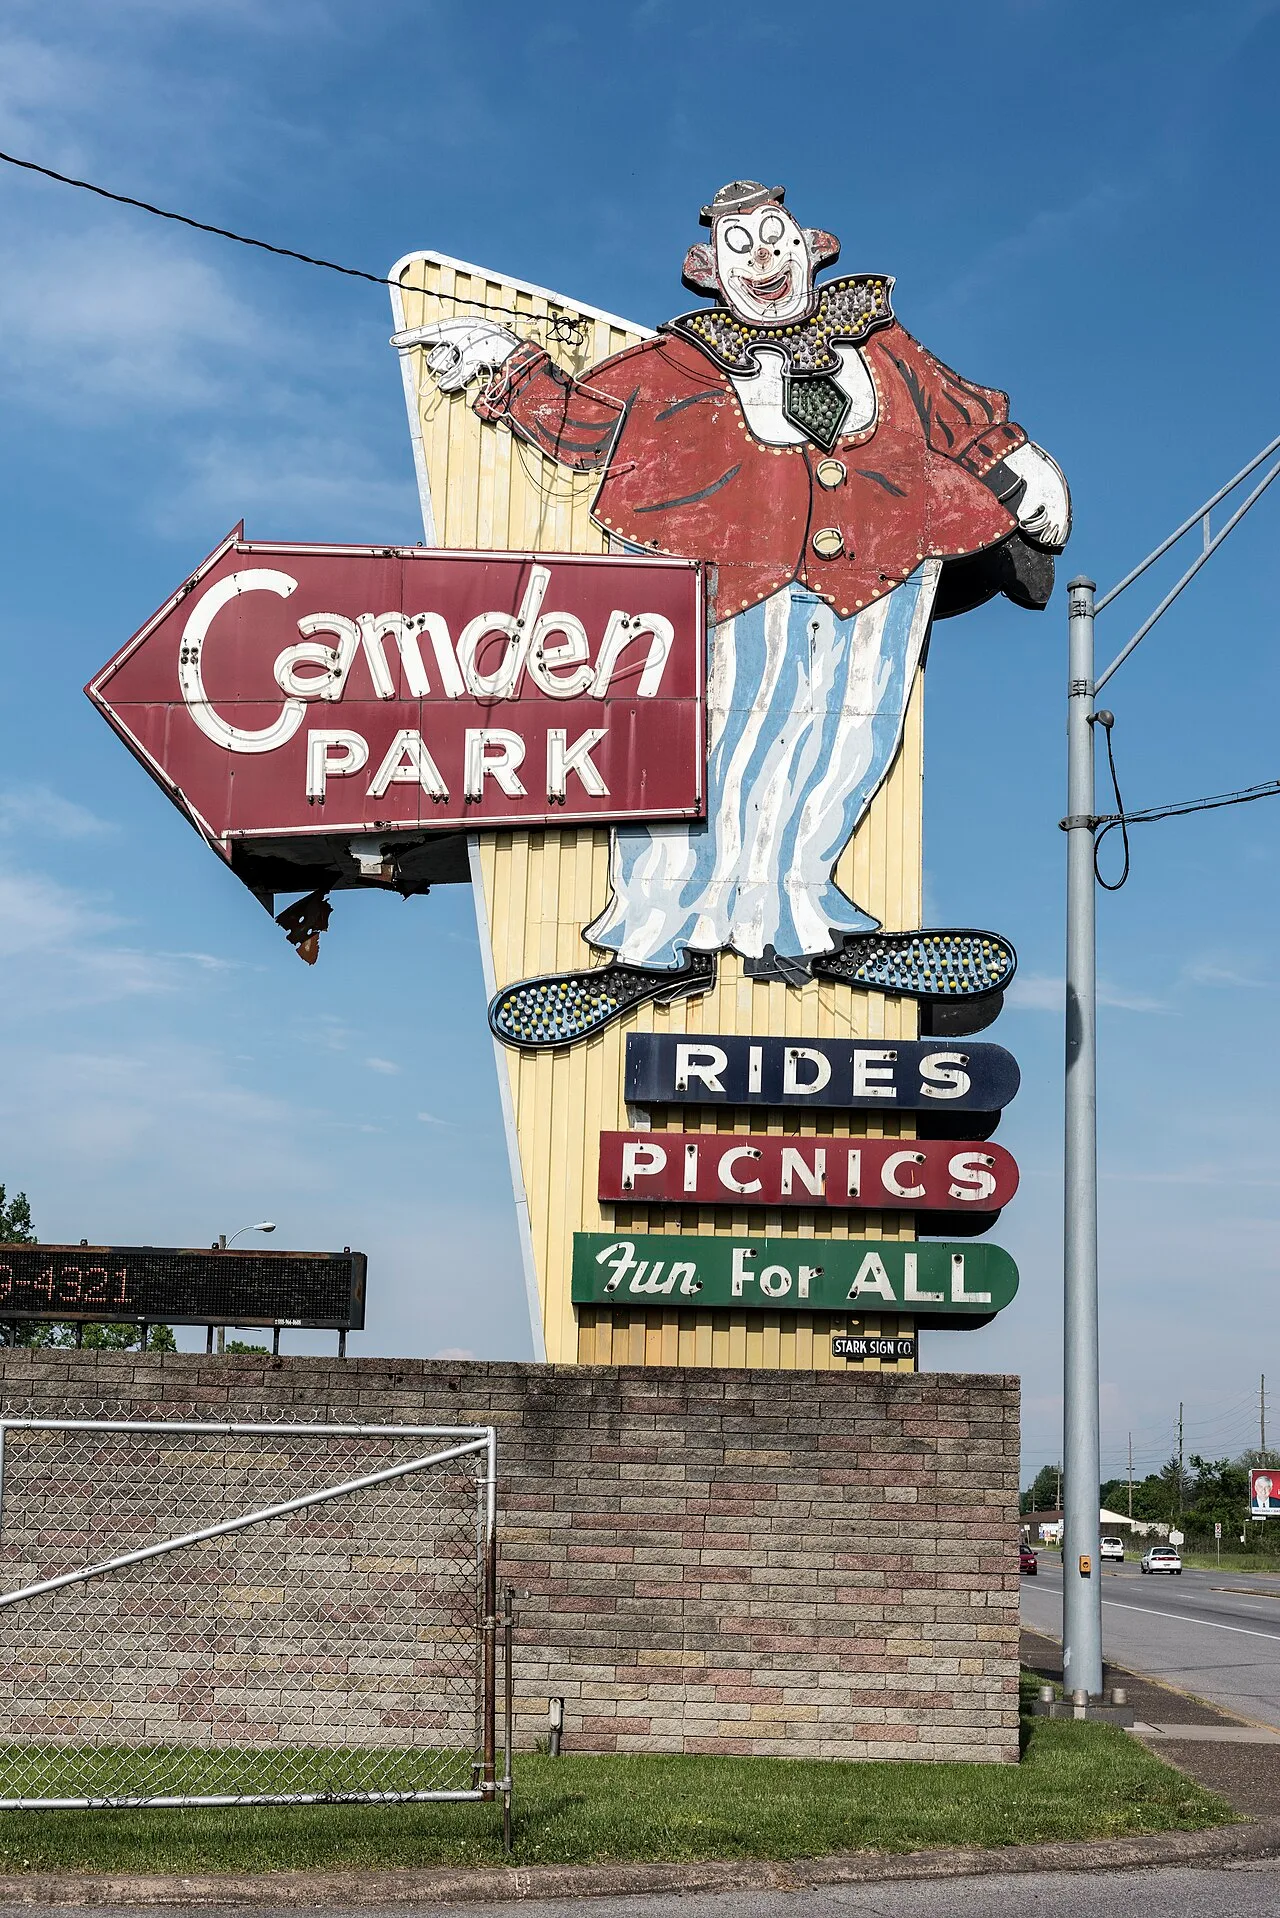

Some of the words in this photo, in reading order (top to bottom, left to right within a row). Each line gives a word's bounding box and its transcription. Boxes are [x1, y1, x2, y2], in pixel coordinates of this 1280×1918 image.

[178, 564, 675, 753] Camden
[305, 728, 611, 799] PARK
[674, 1043, 972, 1100] RIDES
[621, 1142, 997, 1201] PICNICS
[595, 1241, 703, 1295] Fun
[731, 1247, 824, 1299] For
[846, 1251, 992, 1304] ALL
[835, 1339, 868, 1354] STARK
[869, 1340, 895, 1355] SIGN
[897, 1341, 913, 1355] CO.
